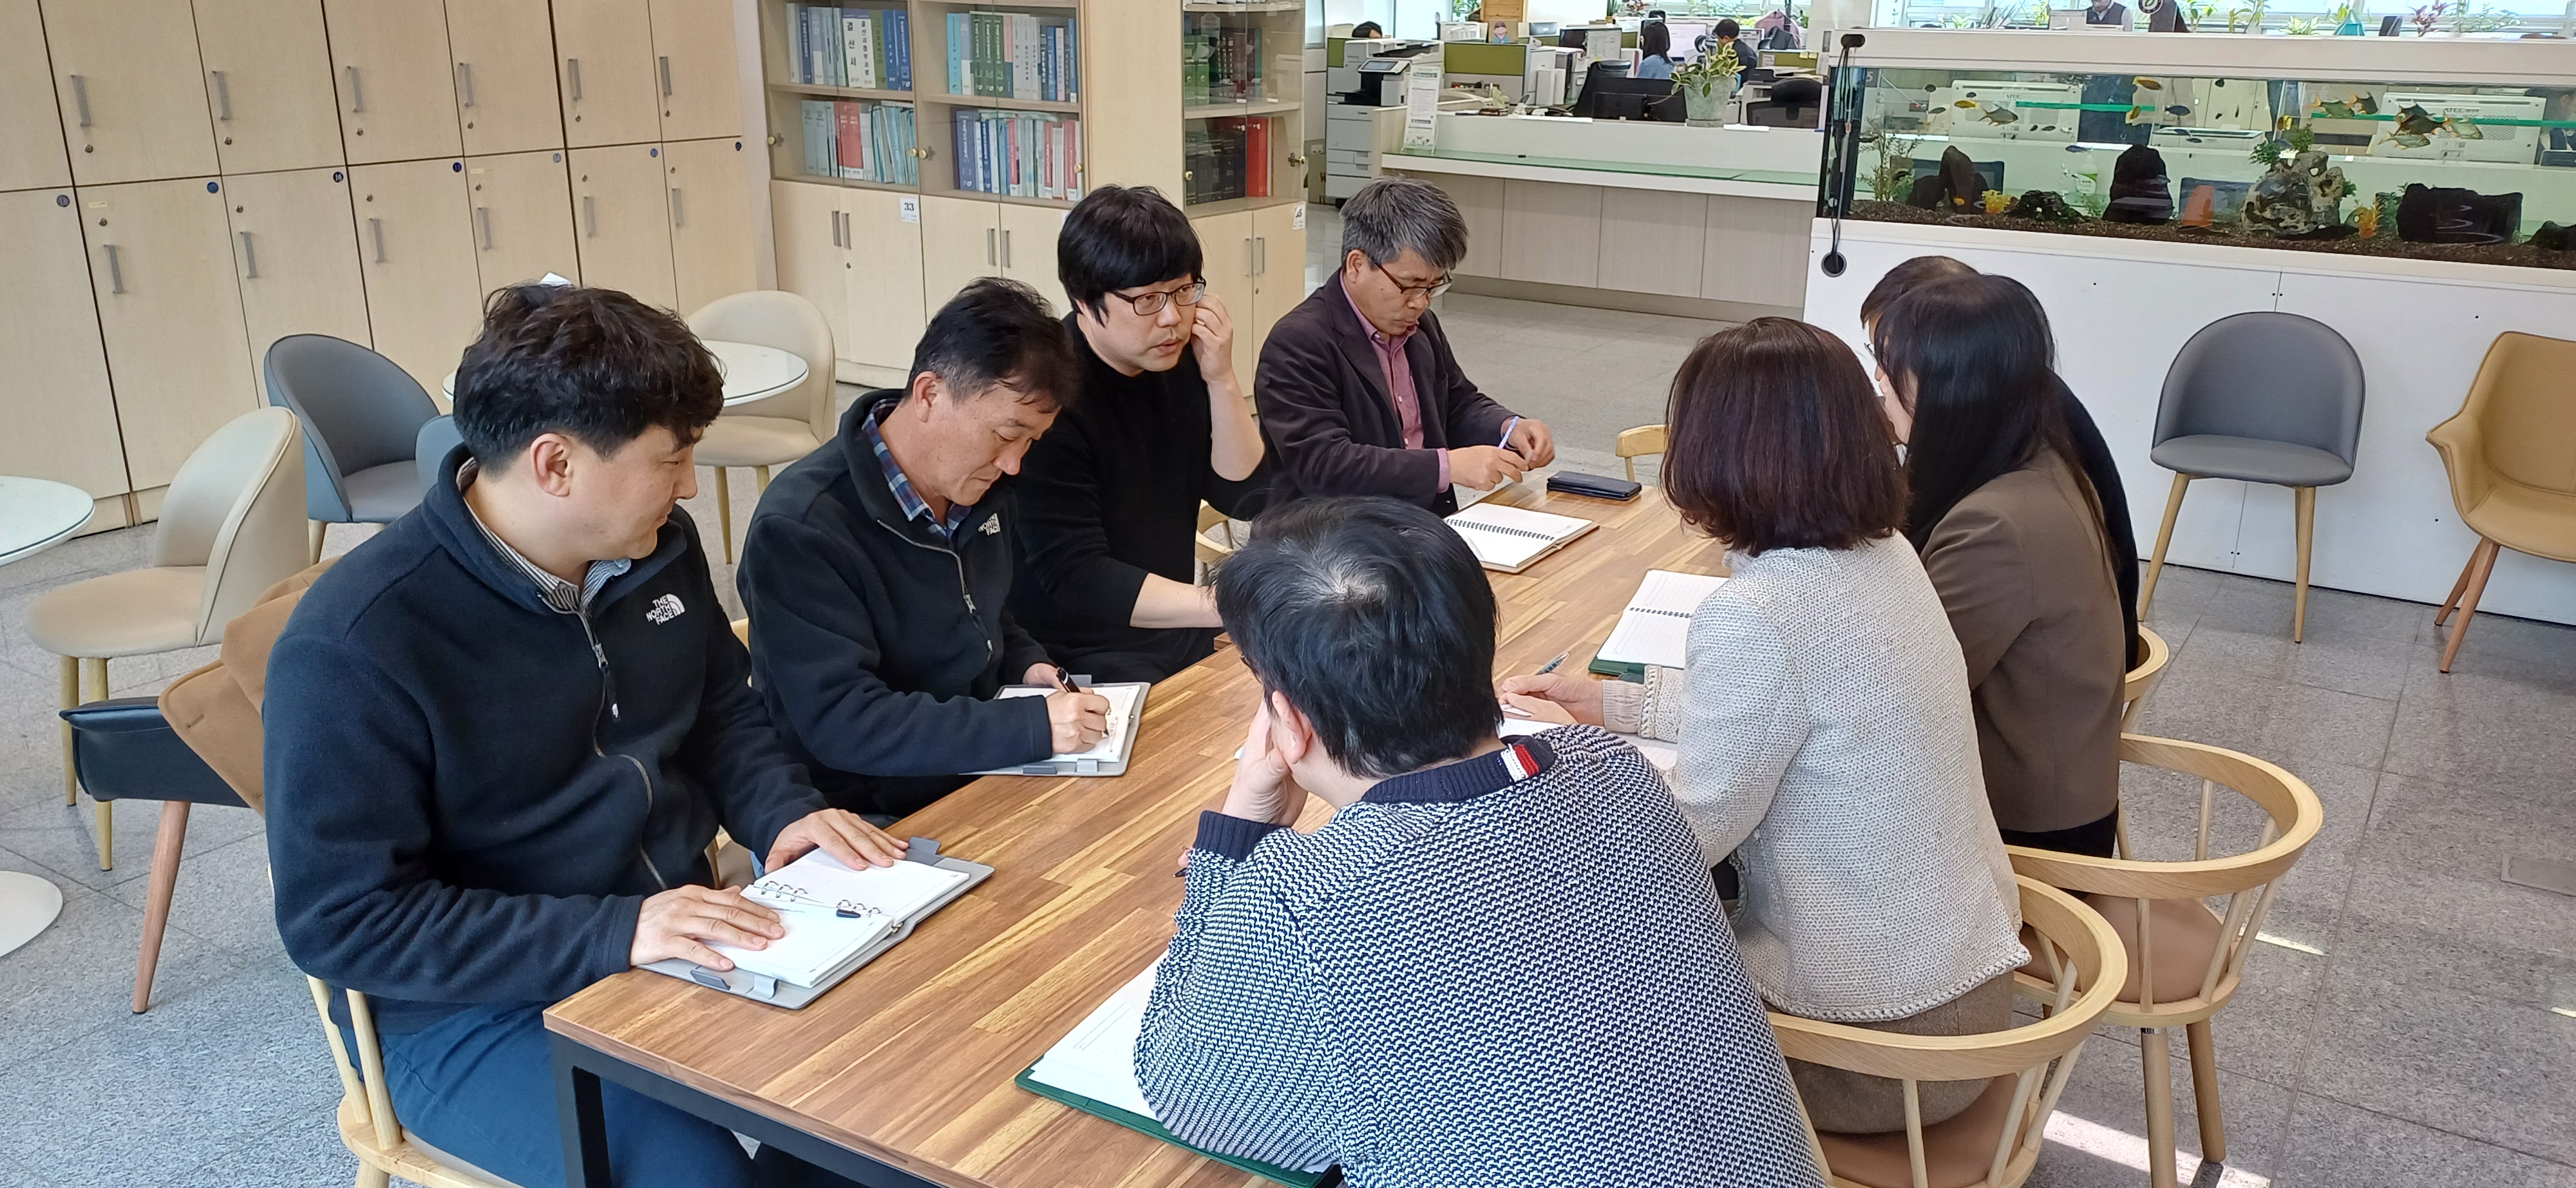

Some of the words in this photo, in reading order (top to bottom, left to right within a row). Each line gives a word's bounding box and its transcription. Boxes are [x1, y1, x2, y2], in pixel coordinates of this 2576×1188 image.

[904, 202, 914, 212] 33
[652, 595, 669, 608] THE
[646, 603, 672, 622] NORTH
[655, 611, 675, 626] FACE
